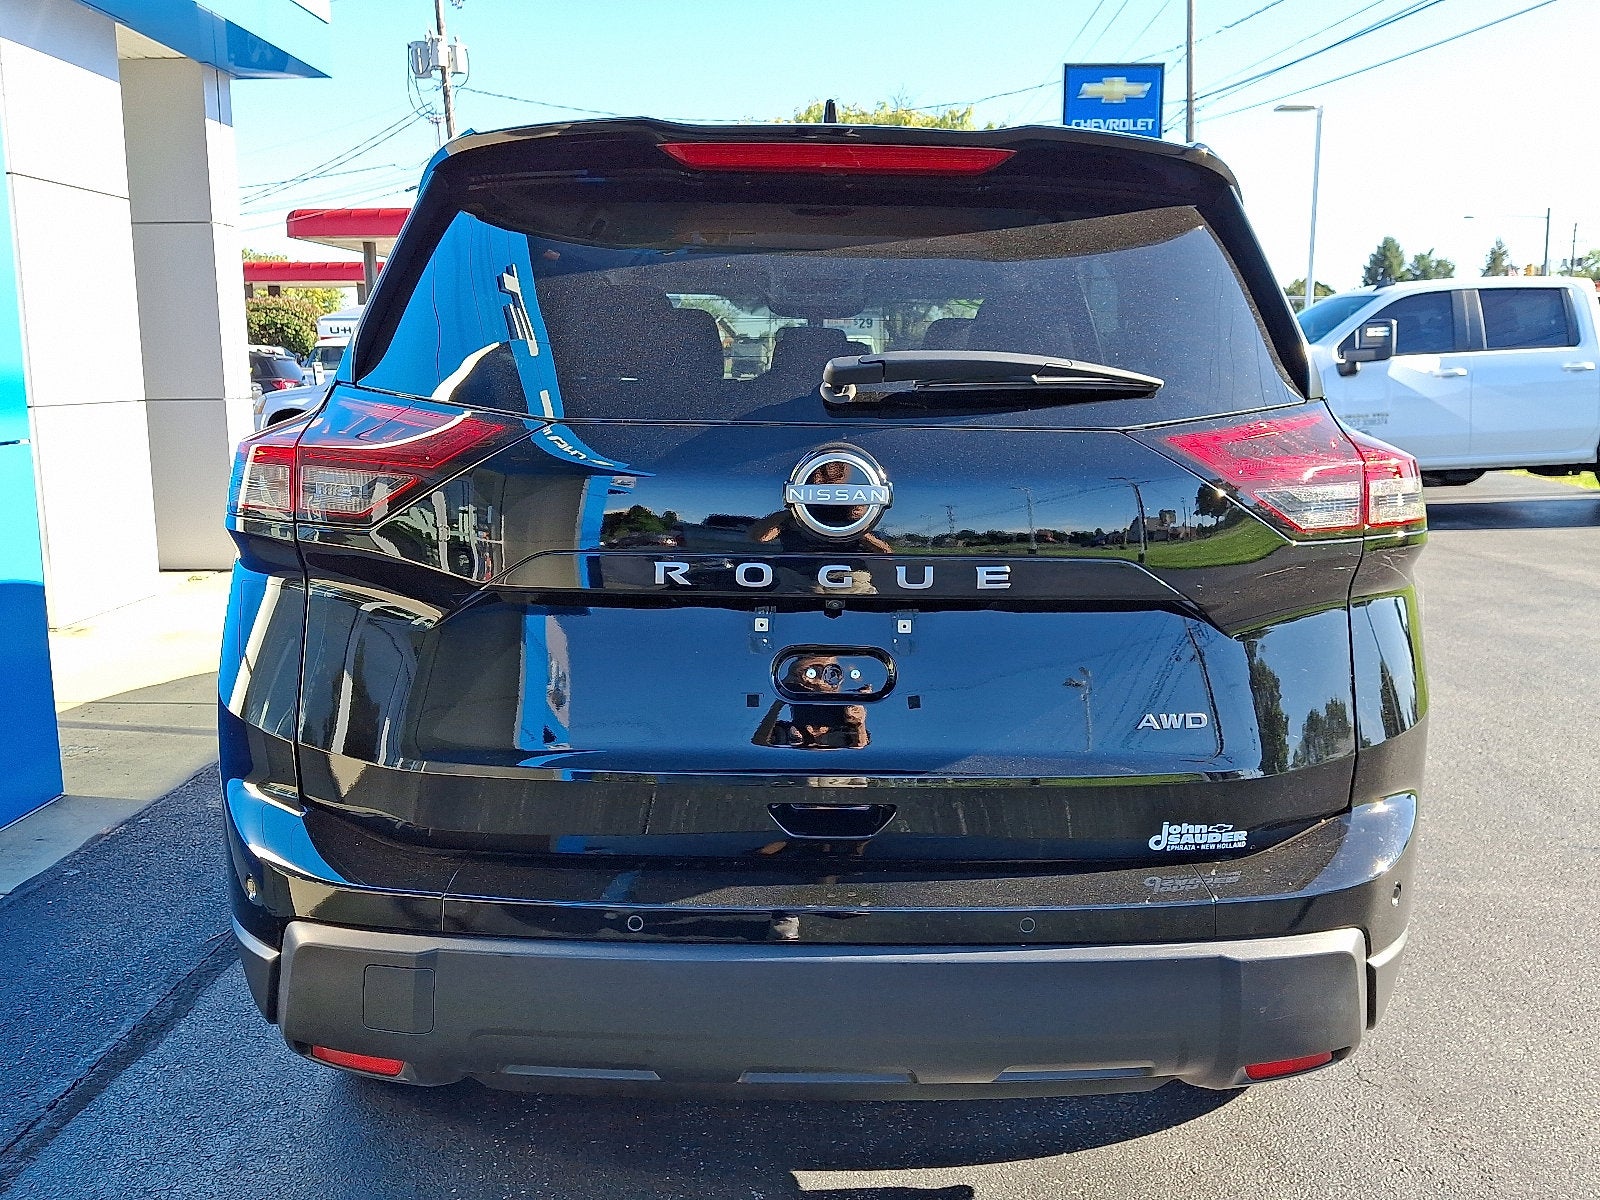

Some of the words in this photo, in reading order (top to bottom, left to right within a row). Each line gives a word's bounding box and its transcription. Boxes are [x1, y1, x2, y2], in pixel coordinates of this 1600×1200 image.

[1071, 118, 1155, 131] CHEVROLET
[789, 488, 886, 502] NISSAN
[653, 560, 1012, 591] ROGUE
[1136, 712, 1208, 730] AWD
[1167, 831, 1248, 844] SAUDER
[1217, 841, 1246, 849] HOLLAND
